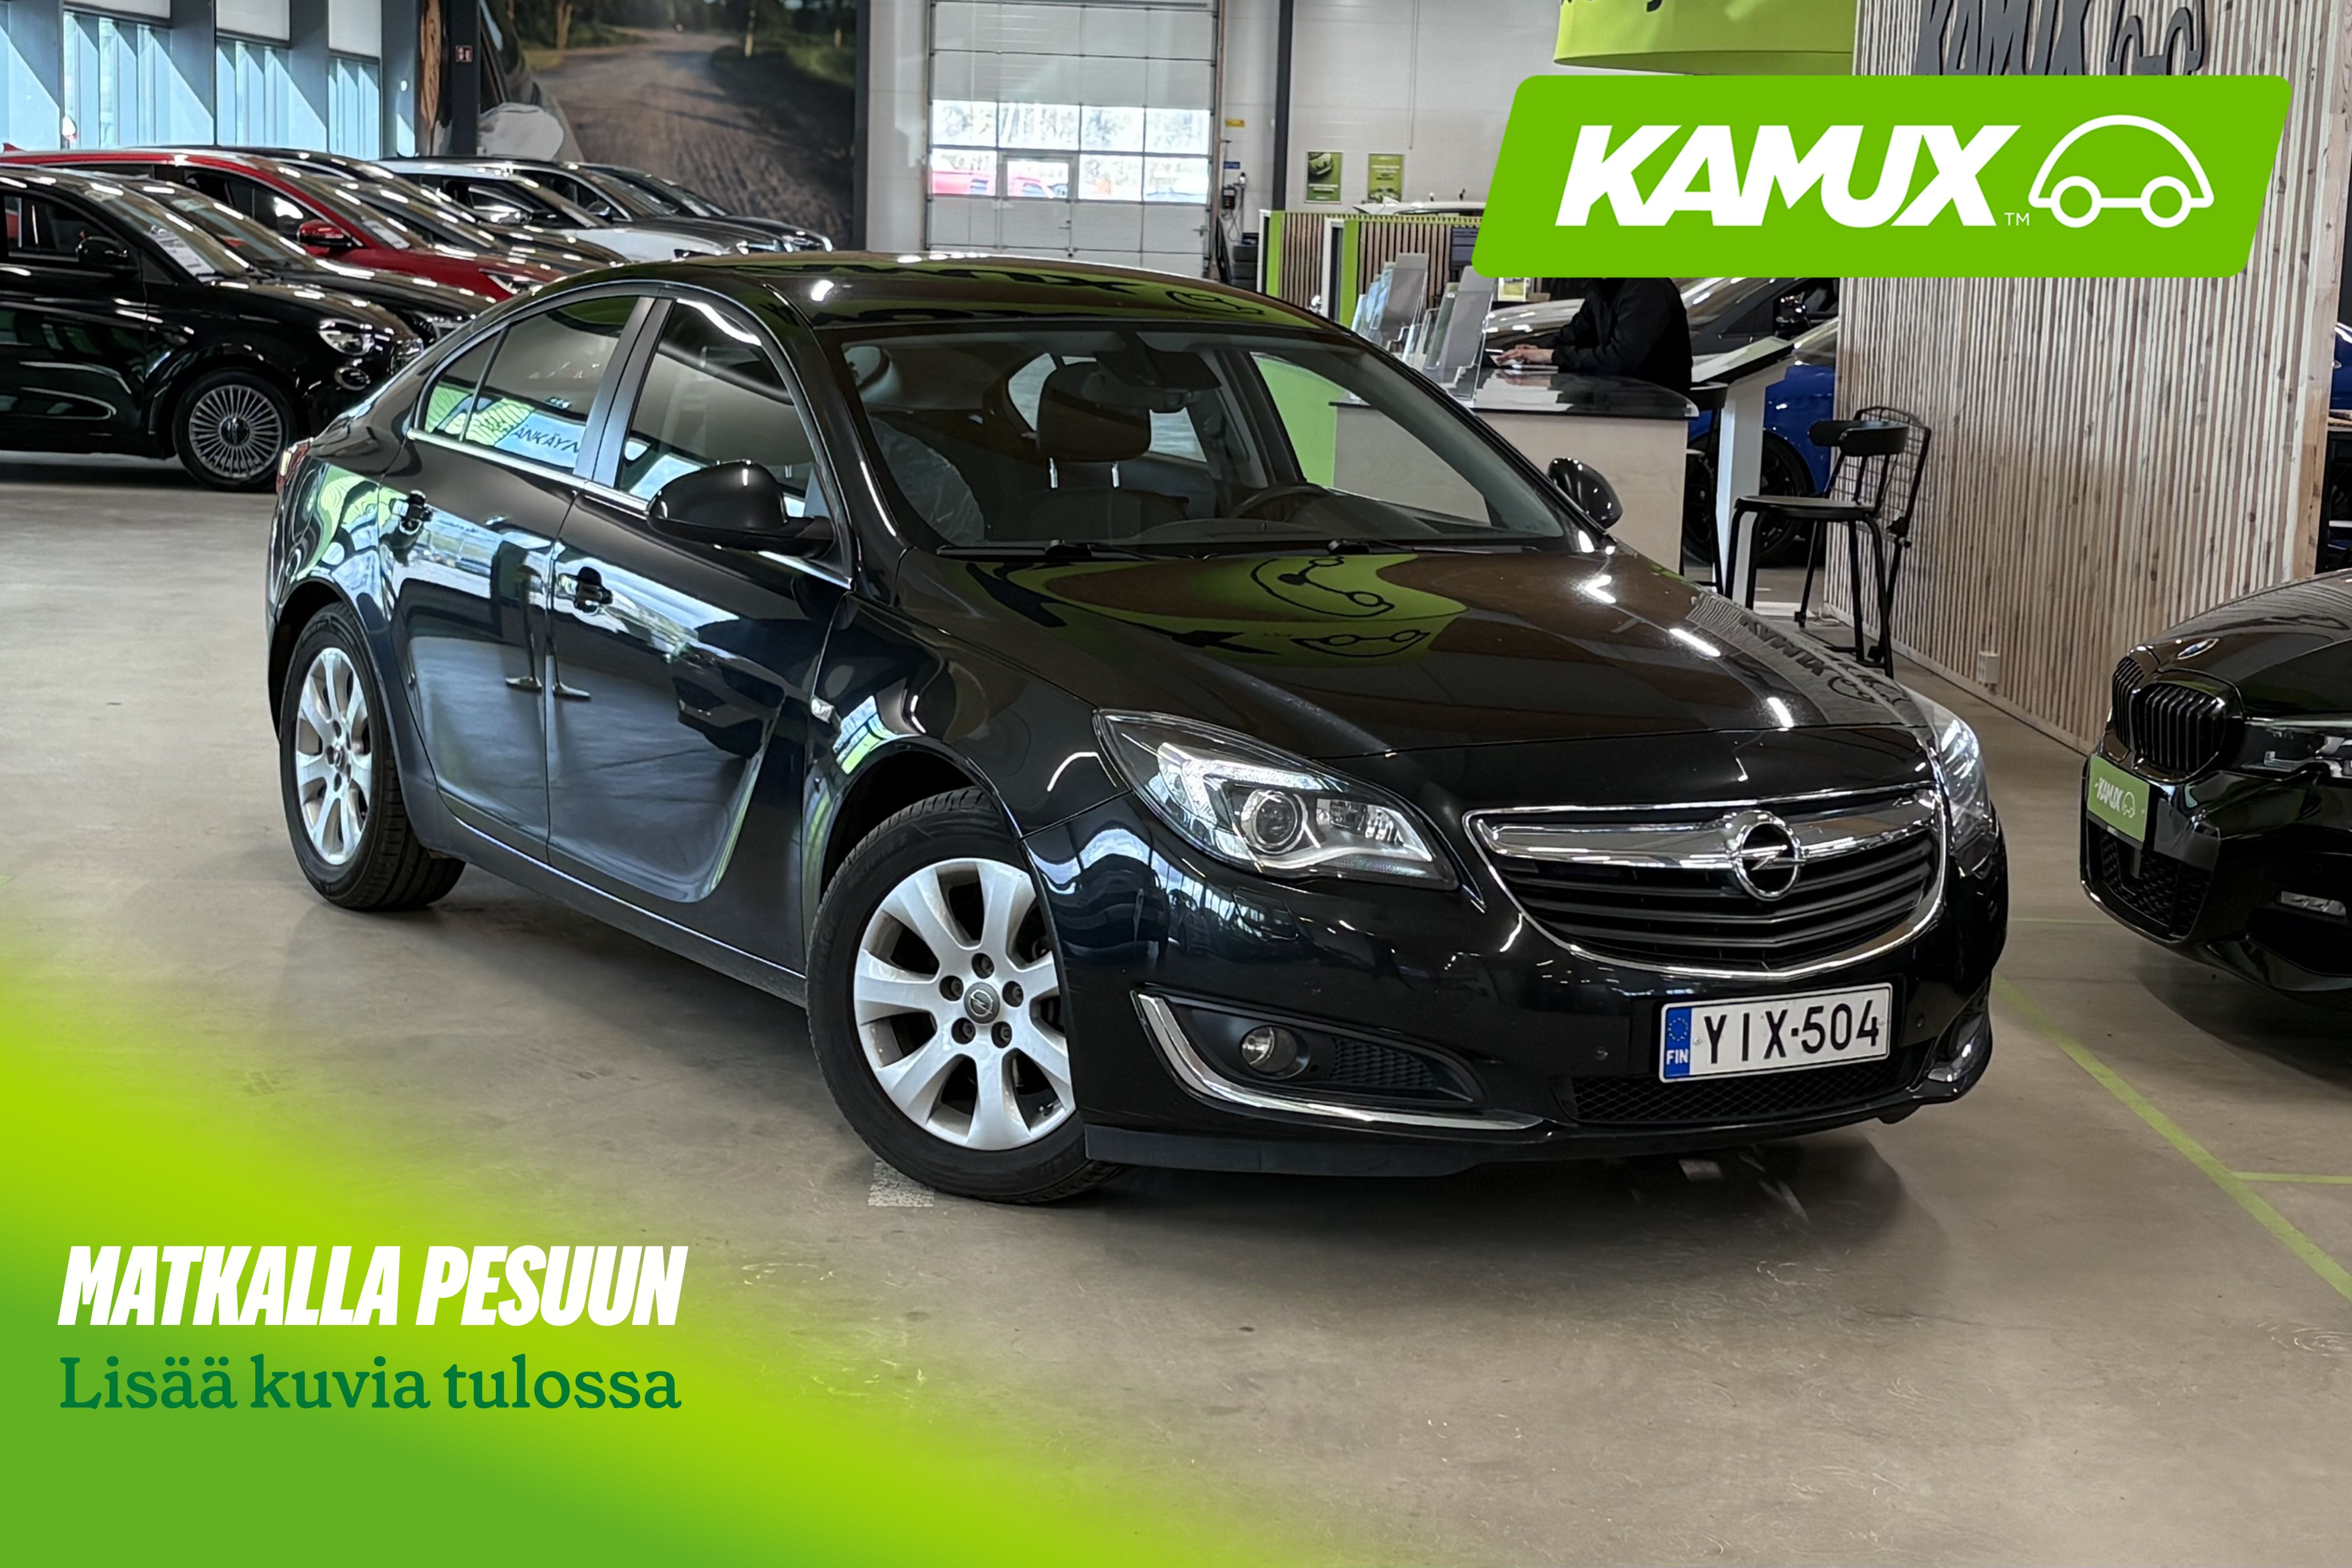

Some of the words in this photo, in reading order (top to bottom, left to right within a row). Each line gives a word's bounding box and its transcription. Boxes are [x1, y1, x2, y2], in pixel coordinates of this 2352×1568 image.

[2097, 776, 2124, 813] KAMUX
[1704, 999, 1879, 1064] YIX-504
[1666, 1048, 1689, 1065] FIN
